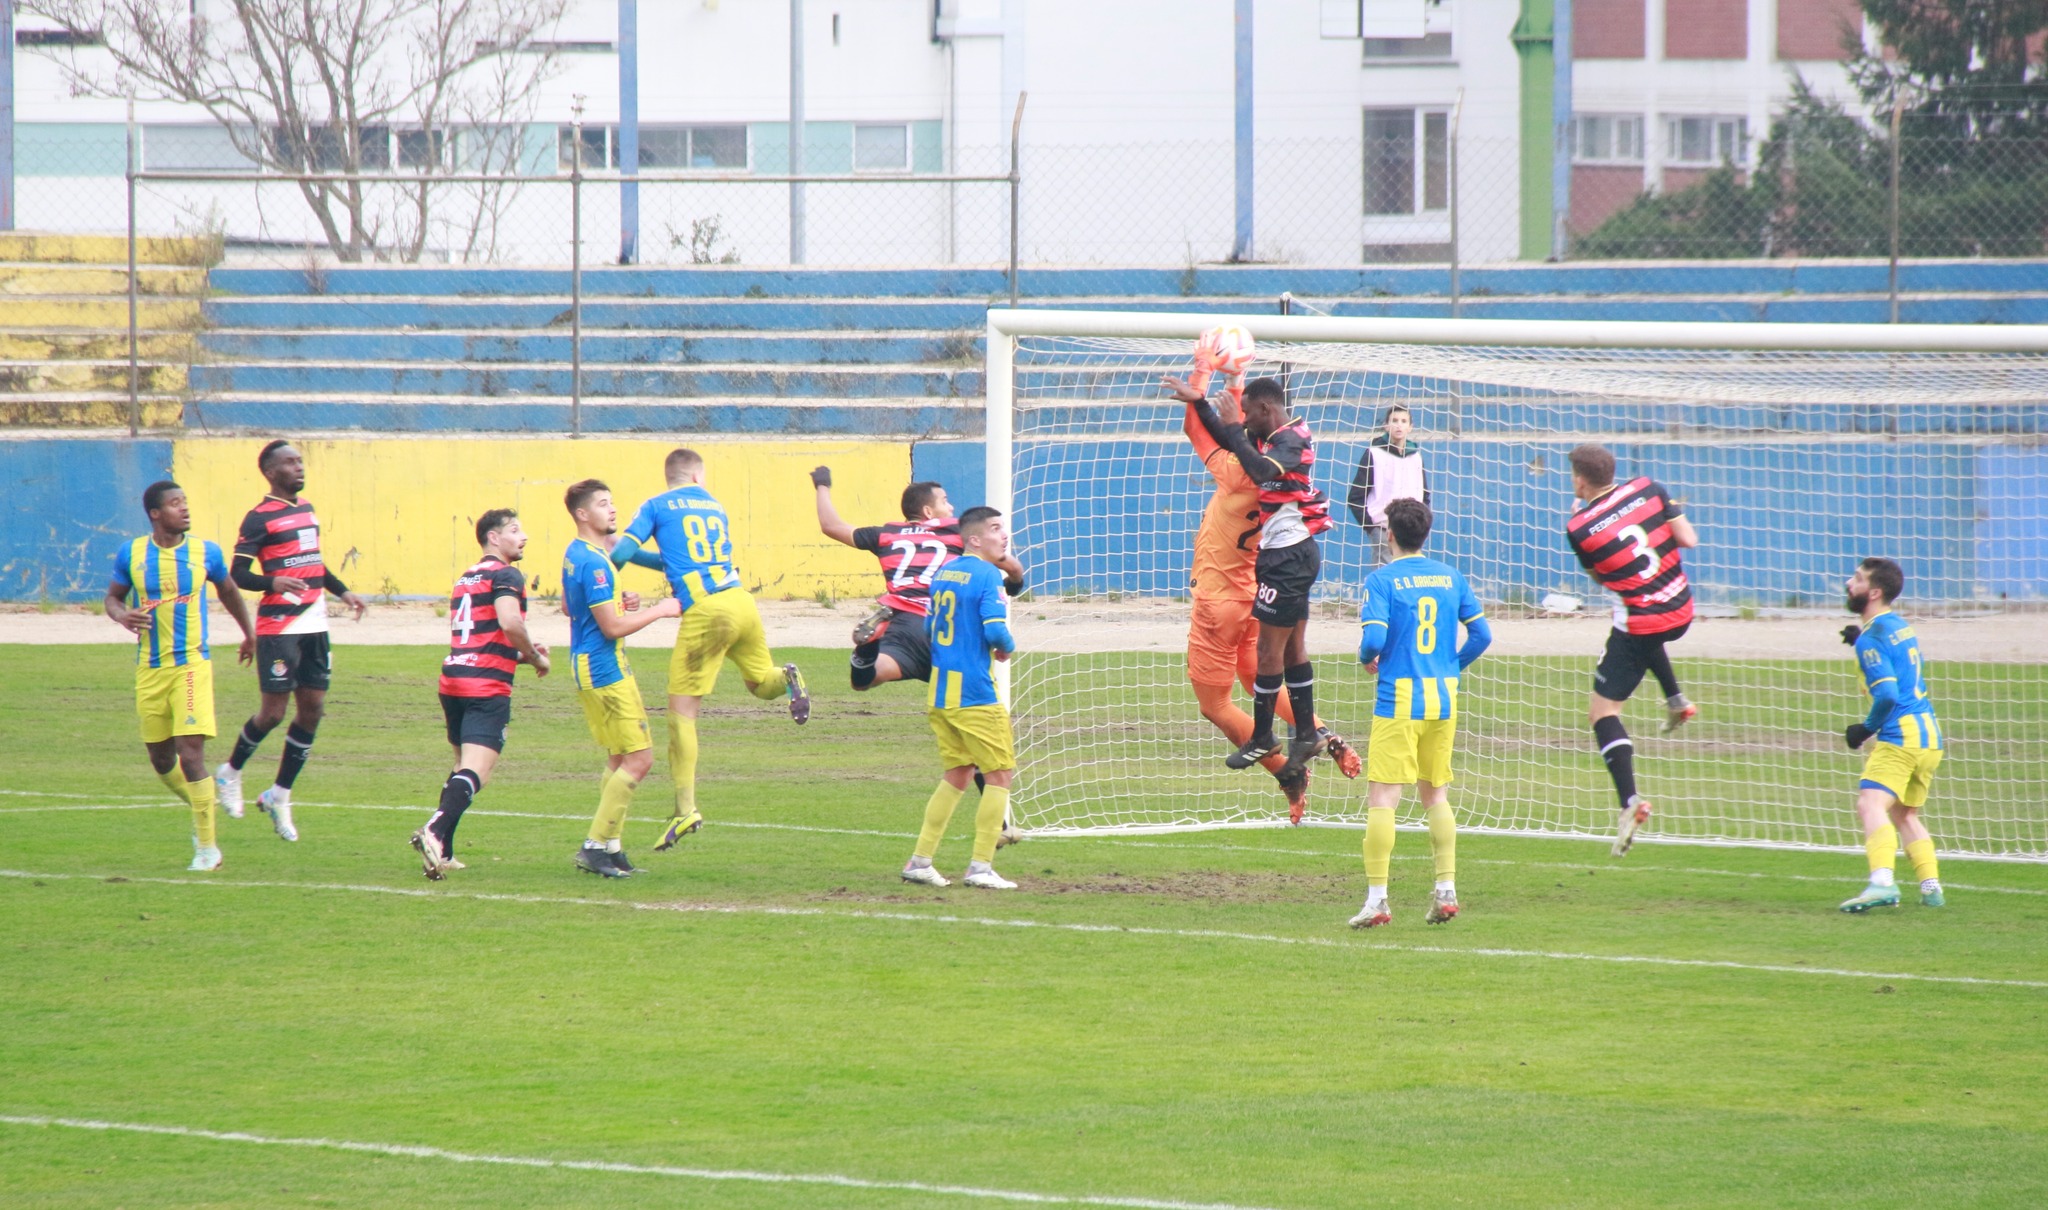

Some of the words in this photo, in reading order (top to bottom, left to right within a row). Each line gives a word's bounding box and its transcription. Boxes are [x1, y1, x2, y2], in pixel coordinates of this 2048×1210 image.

[682, 514, 729, 563] 82
[1589, 512, 1619, 536] PEDRO
[1618, 496, 1646, 518] NUNO
[891, 540, 948, 588] 22
[1617, 524, 1661, 580] 3
[1258, 583, 1277, 605] 80
[1394, 577, 1404, 590] G.
[1403, 576, 1413, 588] D.
[1412, 575, 1453, 590] BRAGANÇA
[451, 592, 475, 644] 4
[931, 590, 956, 646] 13
[1416, 596, 1438, 655] 8
